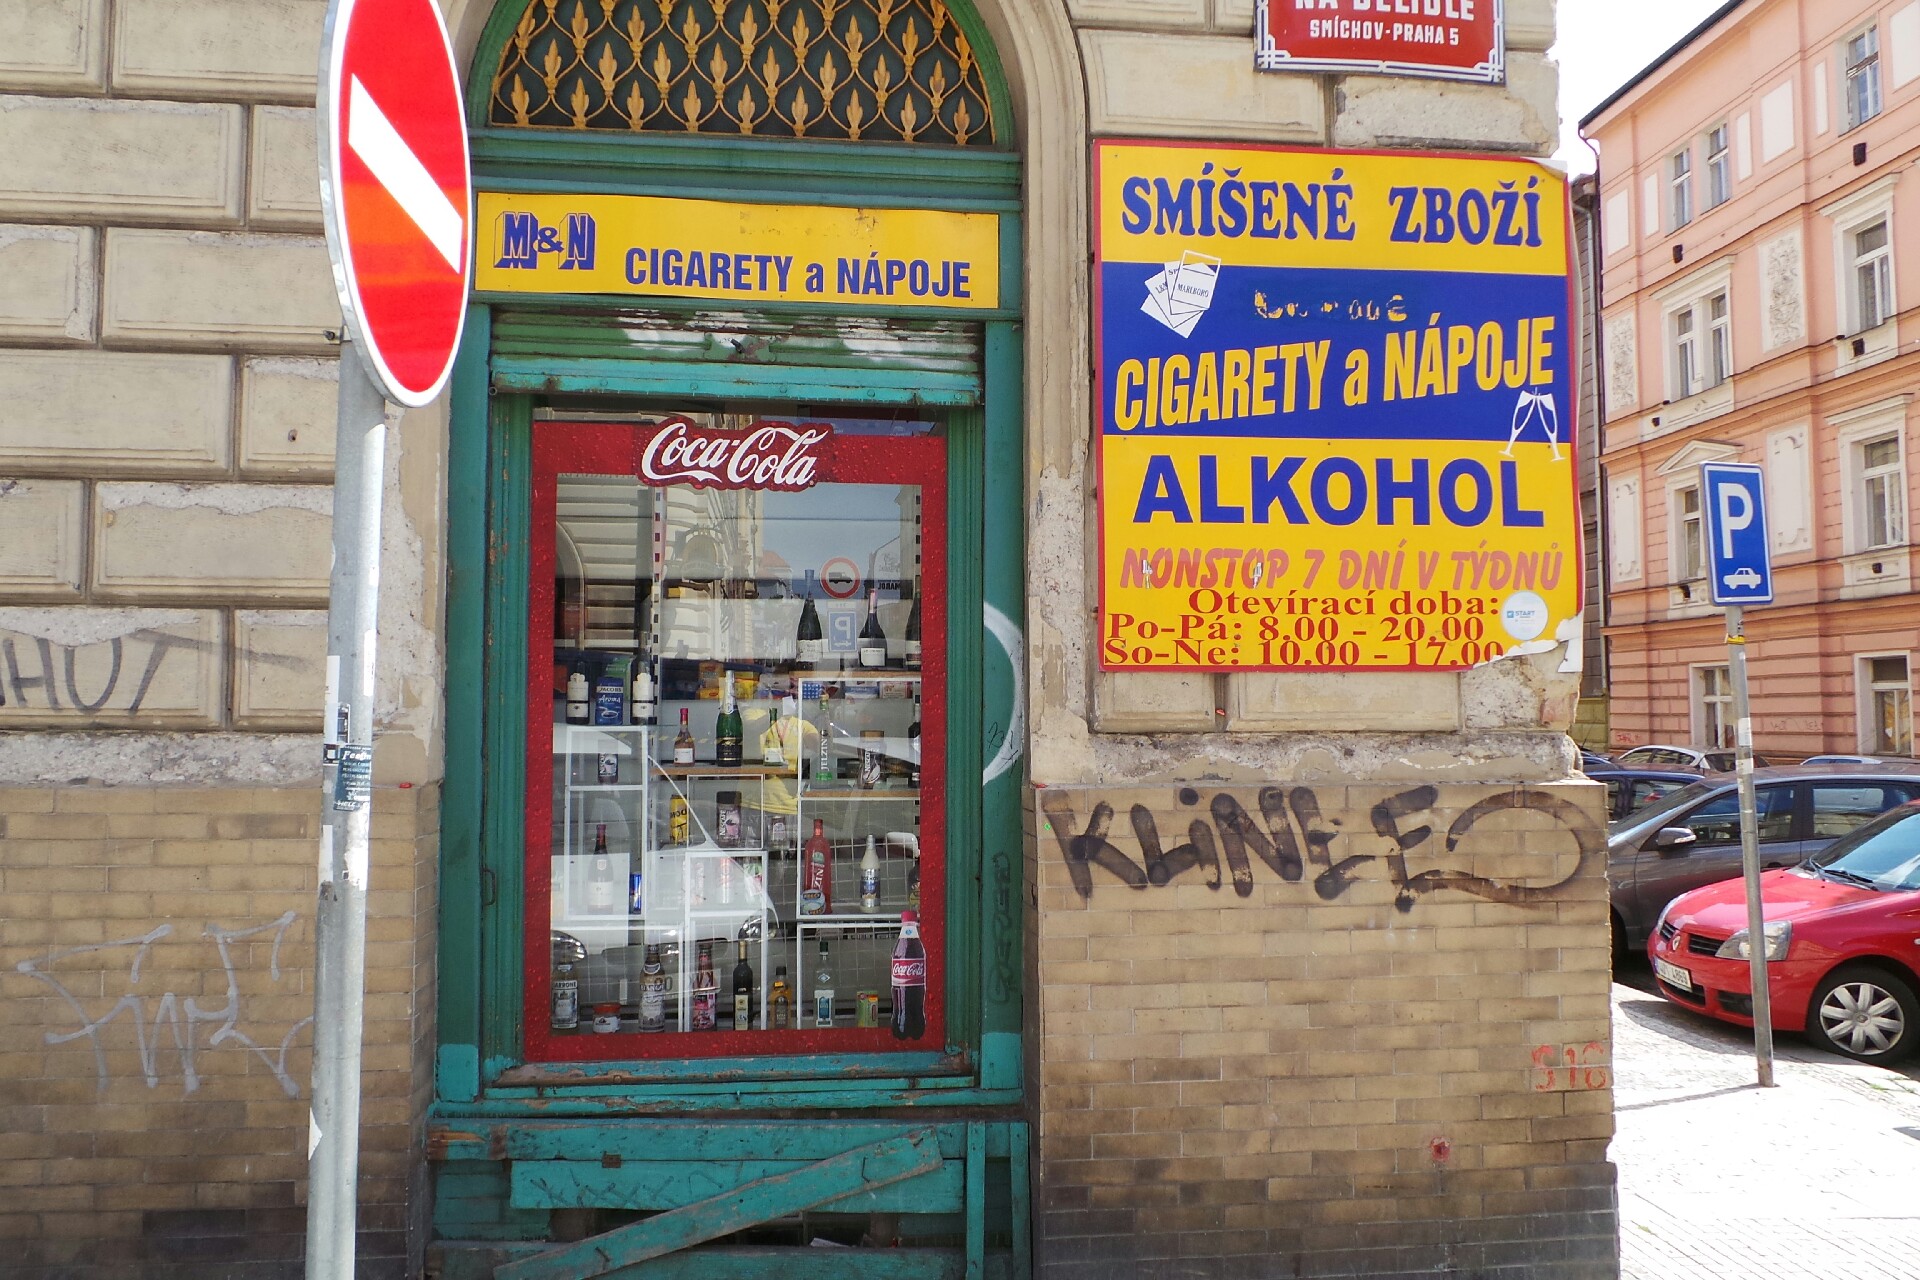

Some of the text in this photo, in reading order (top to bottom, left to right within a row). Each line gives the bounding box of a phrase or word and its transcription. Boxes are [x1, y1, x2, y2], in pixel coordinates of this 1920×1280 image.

[1449, 28, 1460, 46] 5
[1121, 161, 1544, 249] SMÍŠENÉ ZBOŽÍ
[493, 211, 595, 270] M&N
[625, 247, 972, 299] CIGARETY a NÁPOJE
[1177, 283, 1210, 299] MARLBORO
[1114, 312, 1556, 432] CIGARETY a NÁPOJE
[641, 422, 829, 485] Coca-Cola
[1132, 454, 1545, 528] ALKOHOL
[1718, 482, 1754, 559] P
[1120, 539, 1563, 592] NONSTOP 7 DNÍ V TÝDNŮ
[1106, 612, 1243, 642] Po-Pá:
[1258, 616, 1340, 643] 8.00
[1380, 616, 1485, 643] 20.00
[1188, 588, 1500, 616] Otevírací doba:
[1104, 638, 1241, 666] So-Ne:
[1258, 641, 1361, 667] 10.00
[1406, 641, 1505, 667] 17.00
[892, 962, 924, 977] Coca-Cola
